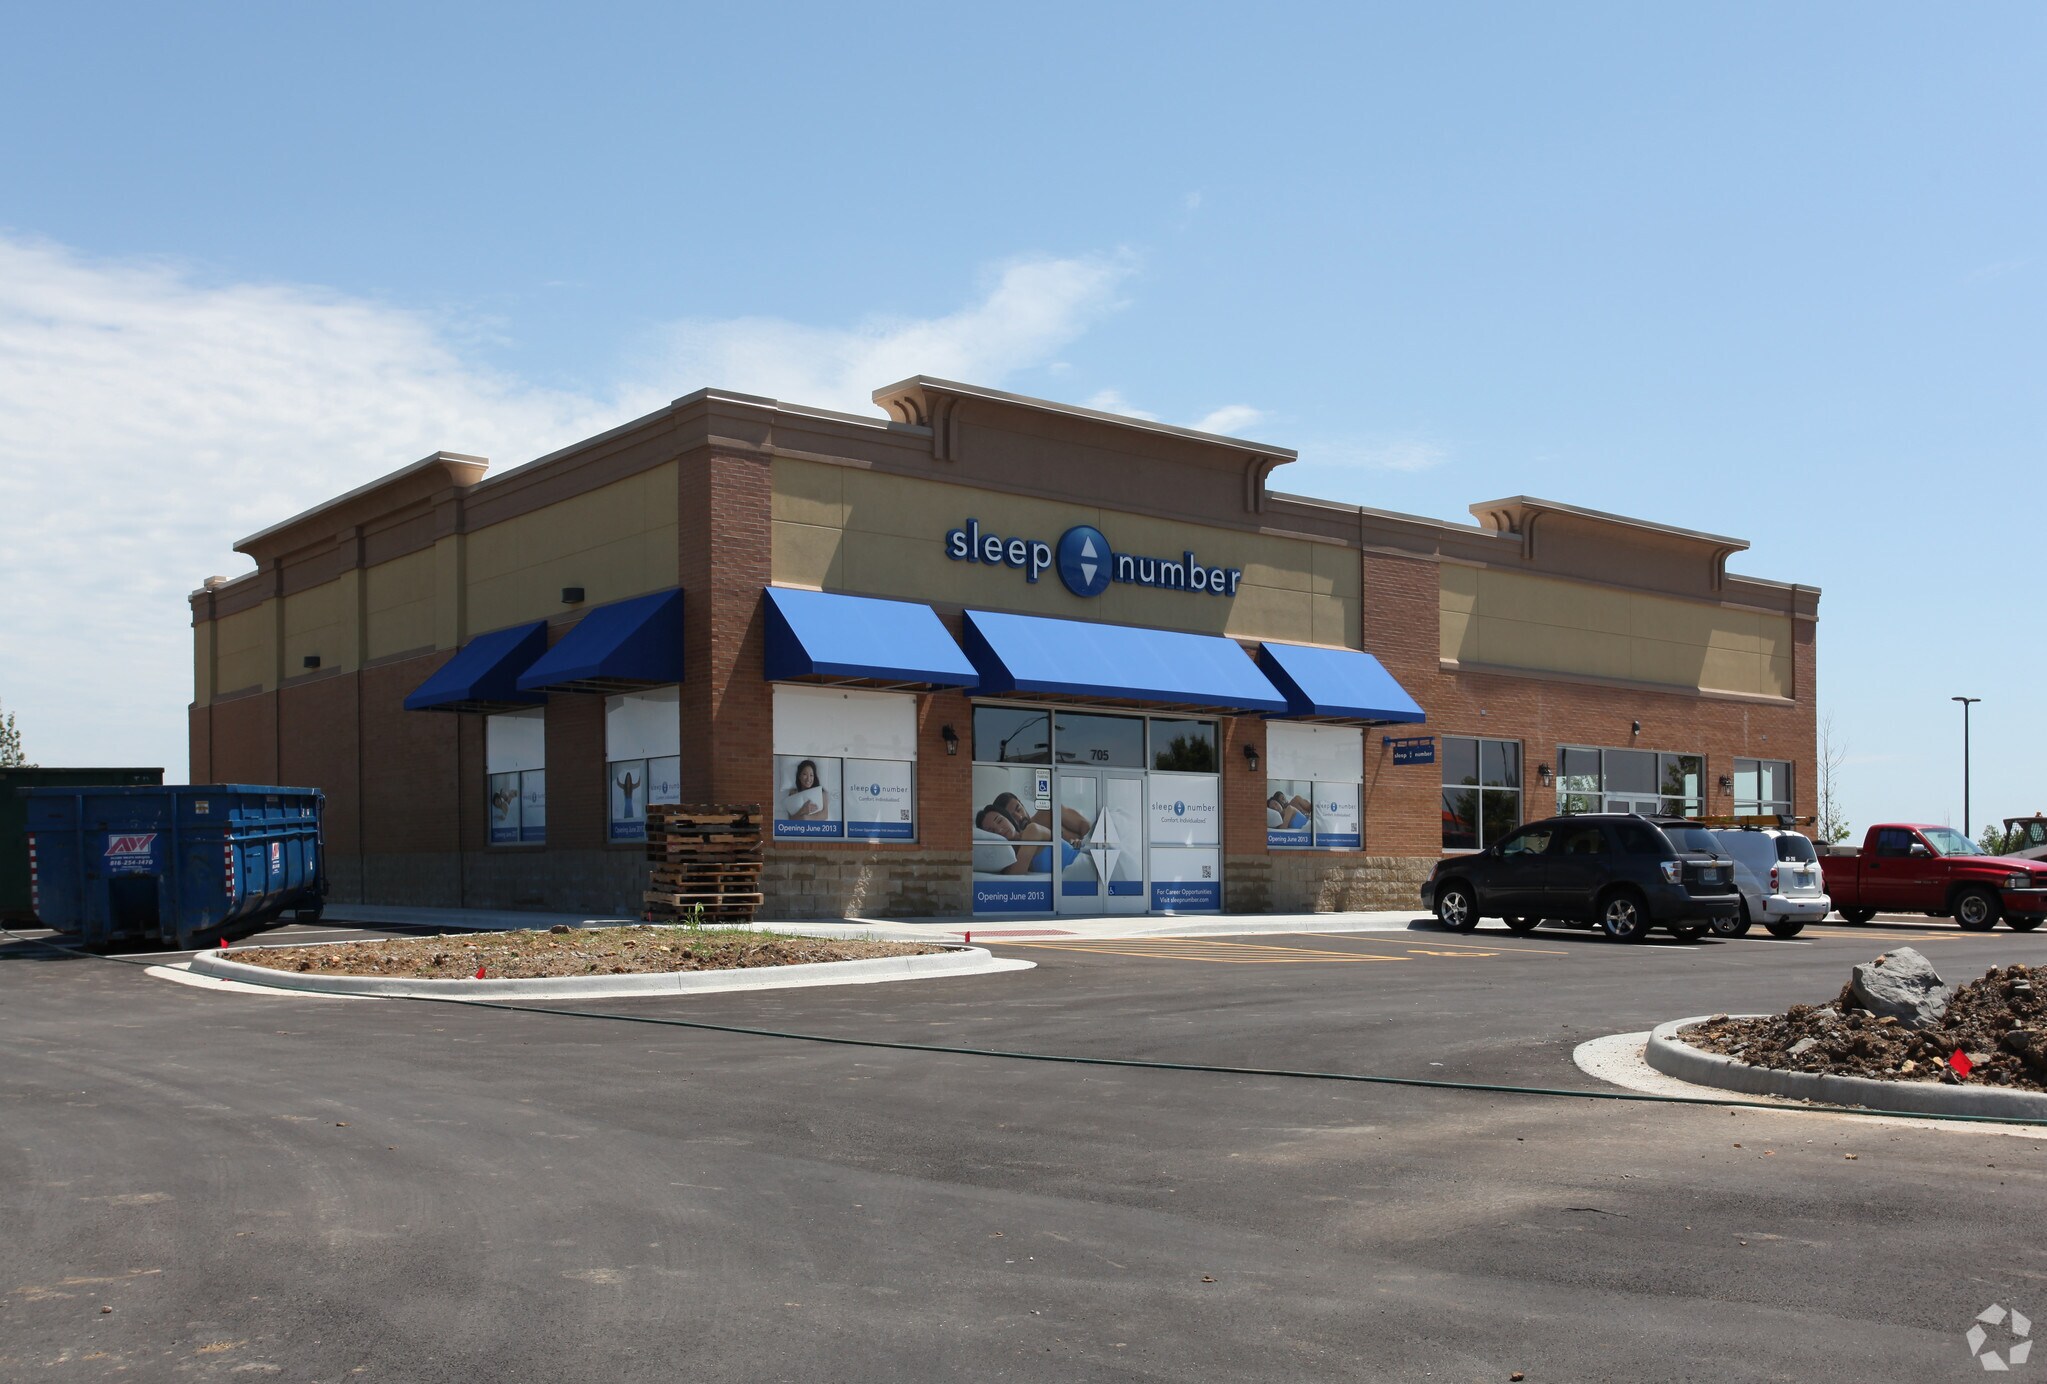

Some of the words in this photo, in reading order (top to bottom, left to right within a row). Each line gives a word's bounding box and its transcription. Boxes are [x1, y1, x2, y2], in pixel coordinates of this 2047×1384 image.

[945, 518, 1052, 583] sleep
[1113, 551, 1241, 597] number
[1090, 749, 1109, 761] 705
[850, 784, 870, 793] sleep
[1151, 801, 1173, 813] sleep
[1187, 803, 1215, 812] number
[778, 824, 805, 833] Opening
[977, 891, 1008, 903] Opening
[1010, 892, 1026, 901] June
[1027, 891, 1045, 901] 2013
